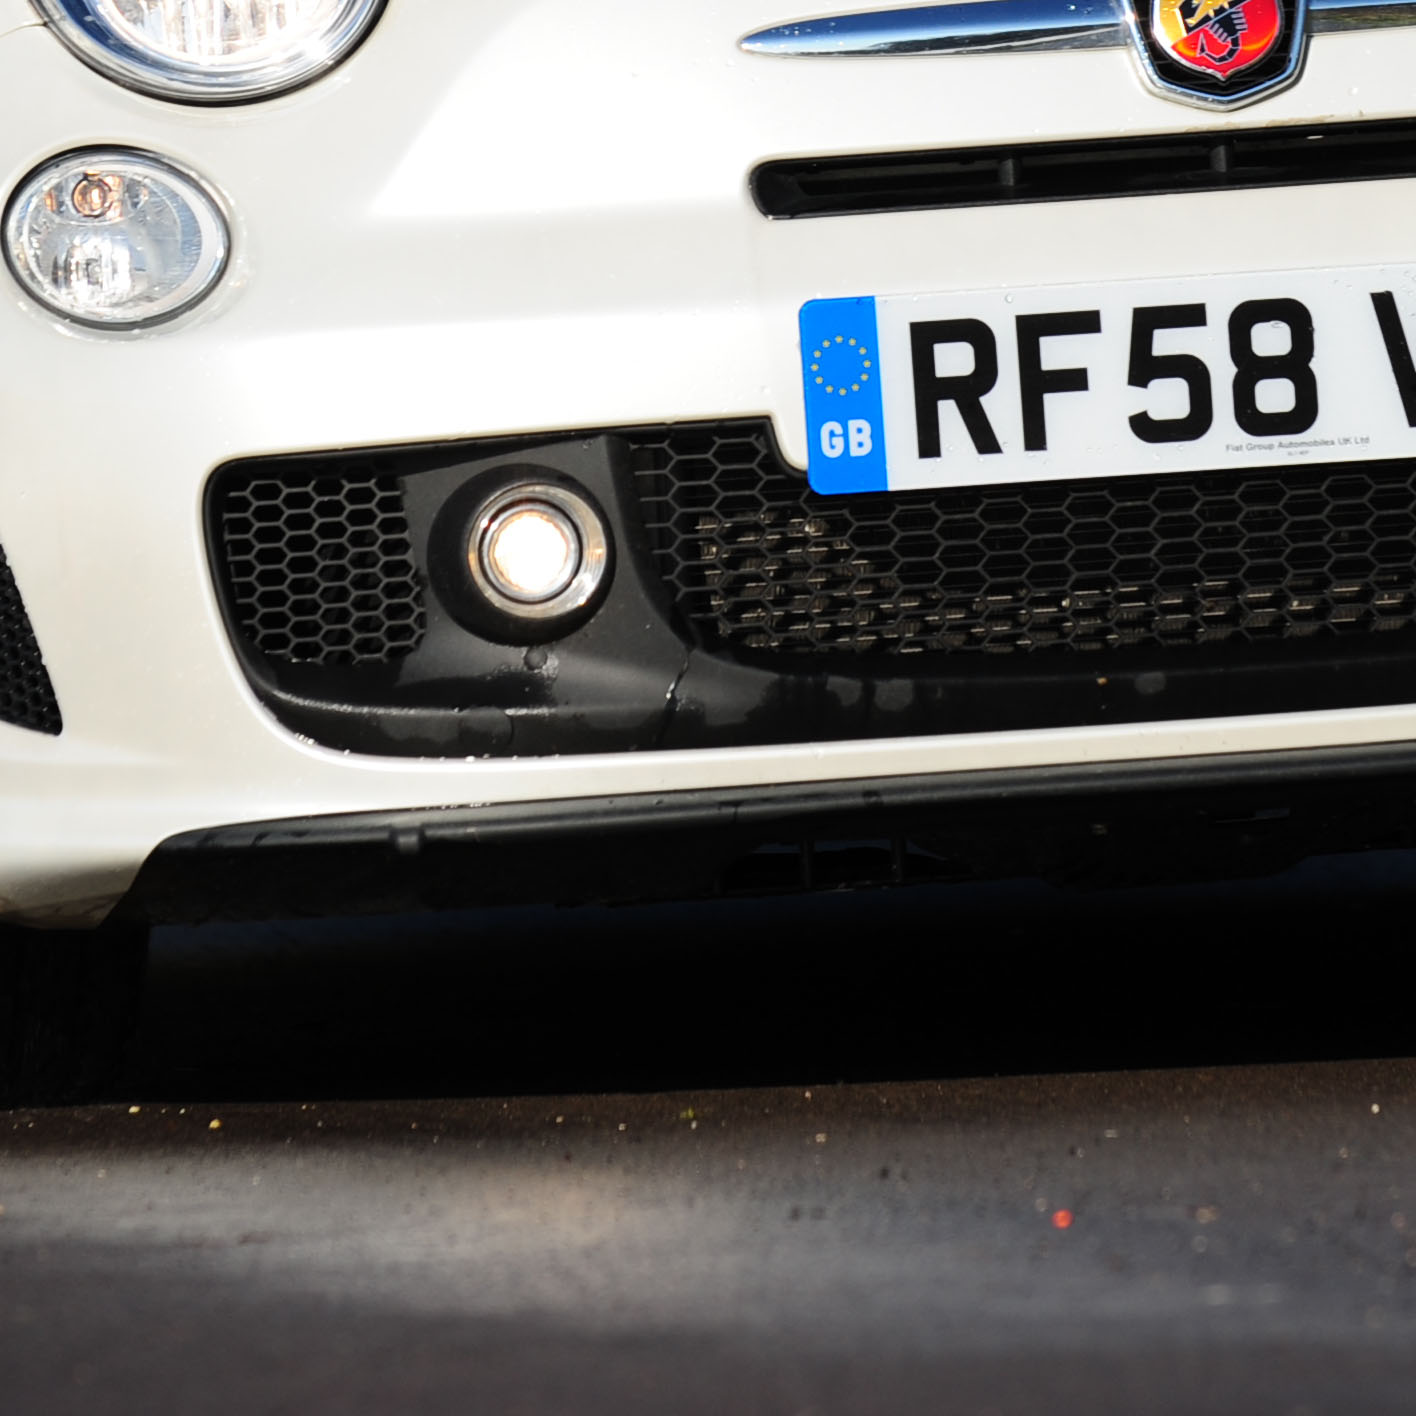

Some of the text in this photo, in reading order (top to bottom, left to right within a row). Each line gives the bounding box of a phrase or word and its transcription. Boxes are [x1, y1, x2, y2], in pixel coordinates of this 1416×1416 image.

[909, 297, 1319, 459] RF58
[820, 418, 873, 458] GB
[1225, 443, 1244, 452] Fiat
[1245, 441, 1275, 452] Group
[1277, 438, 1335, 449] Automobiles
